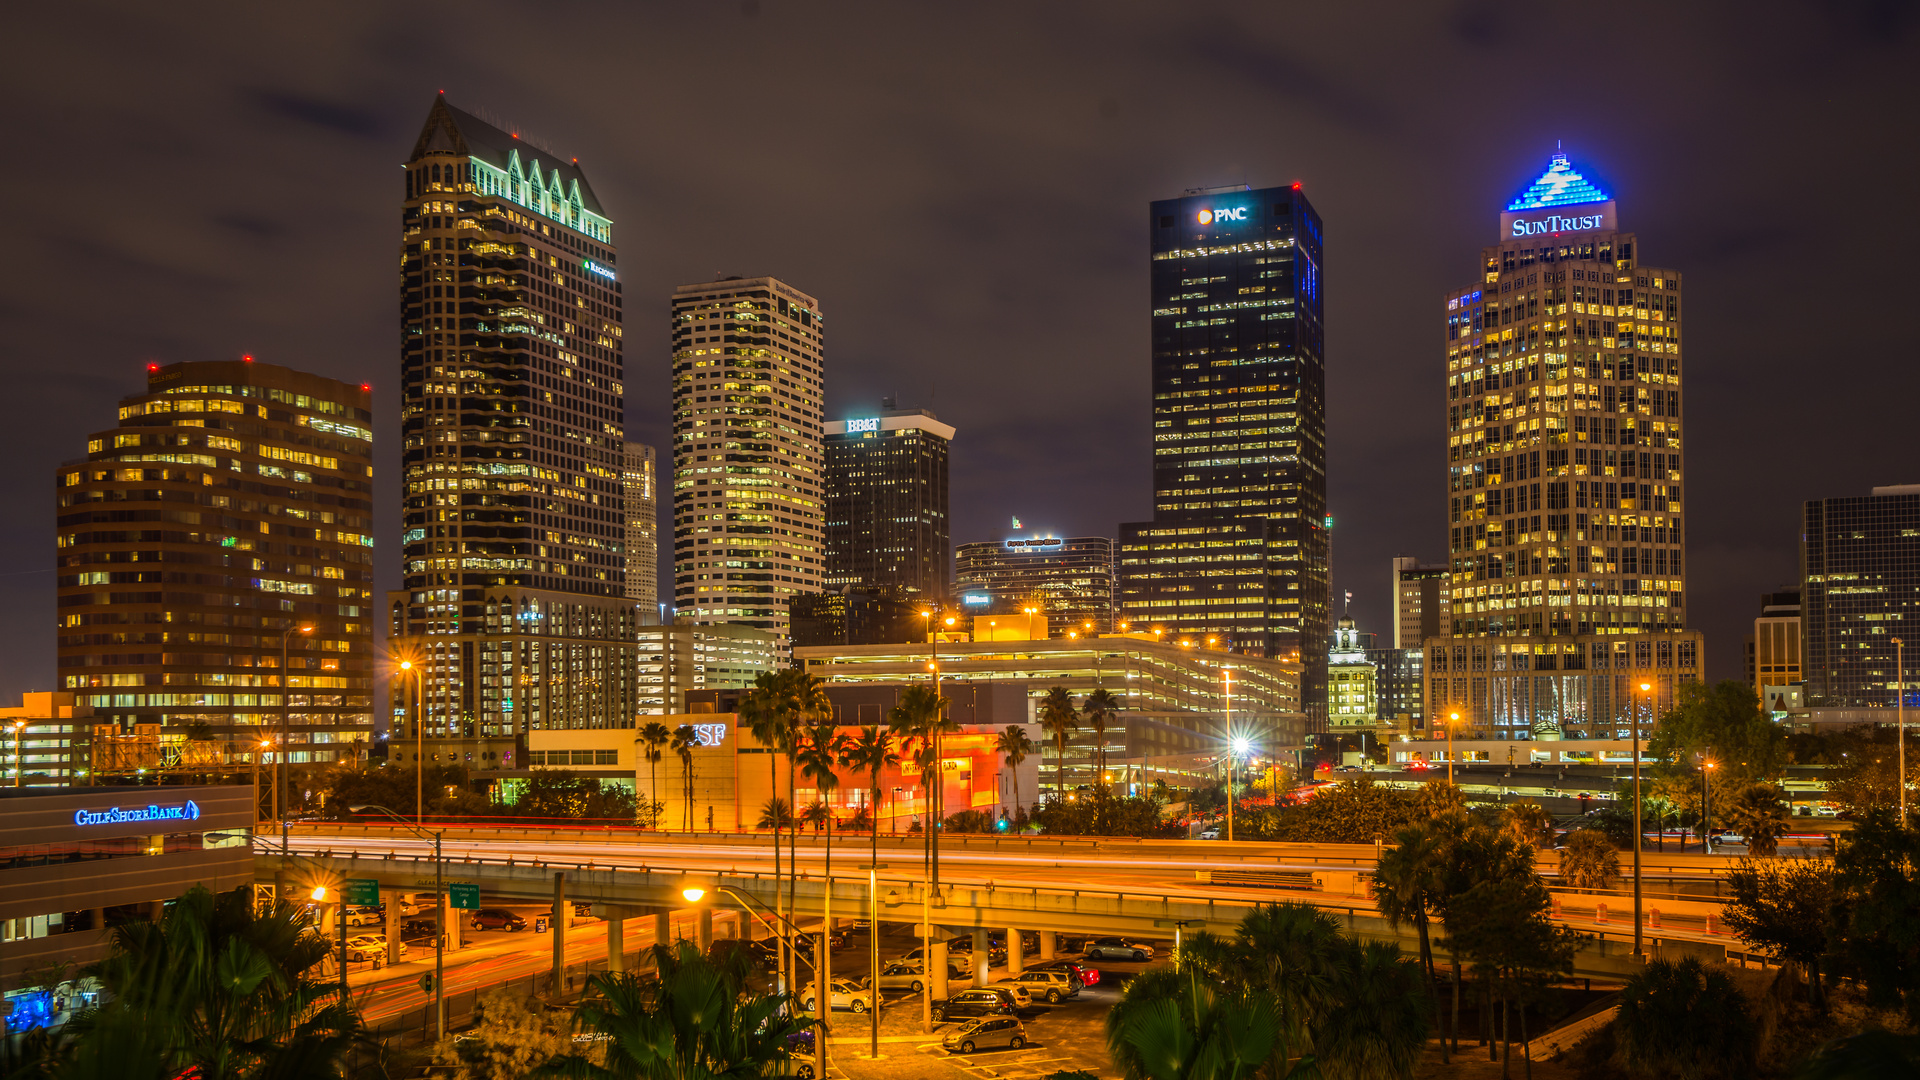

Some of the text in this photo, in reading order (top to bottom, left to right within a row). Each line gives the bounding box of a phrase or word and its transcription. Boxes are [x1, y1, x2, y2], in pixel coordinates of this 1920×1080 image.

[1214, 206, 1247, 223] PNC
[847, 417, 880, 432] BB&T
[965, 595, 989, 604] Hilton
[417, 879, 450, 887] CLEARNCE
